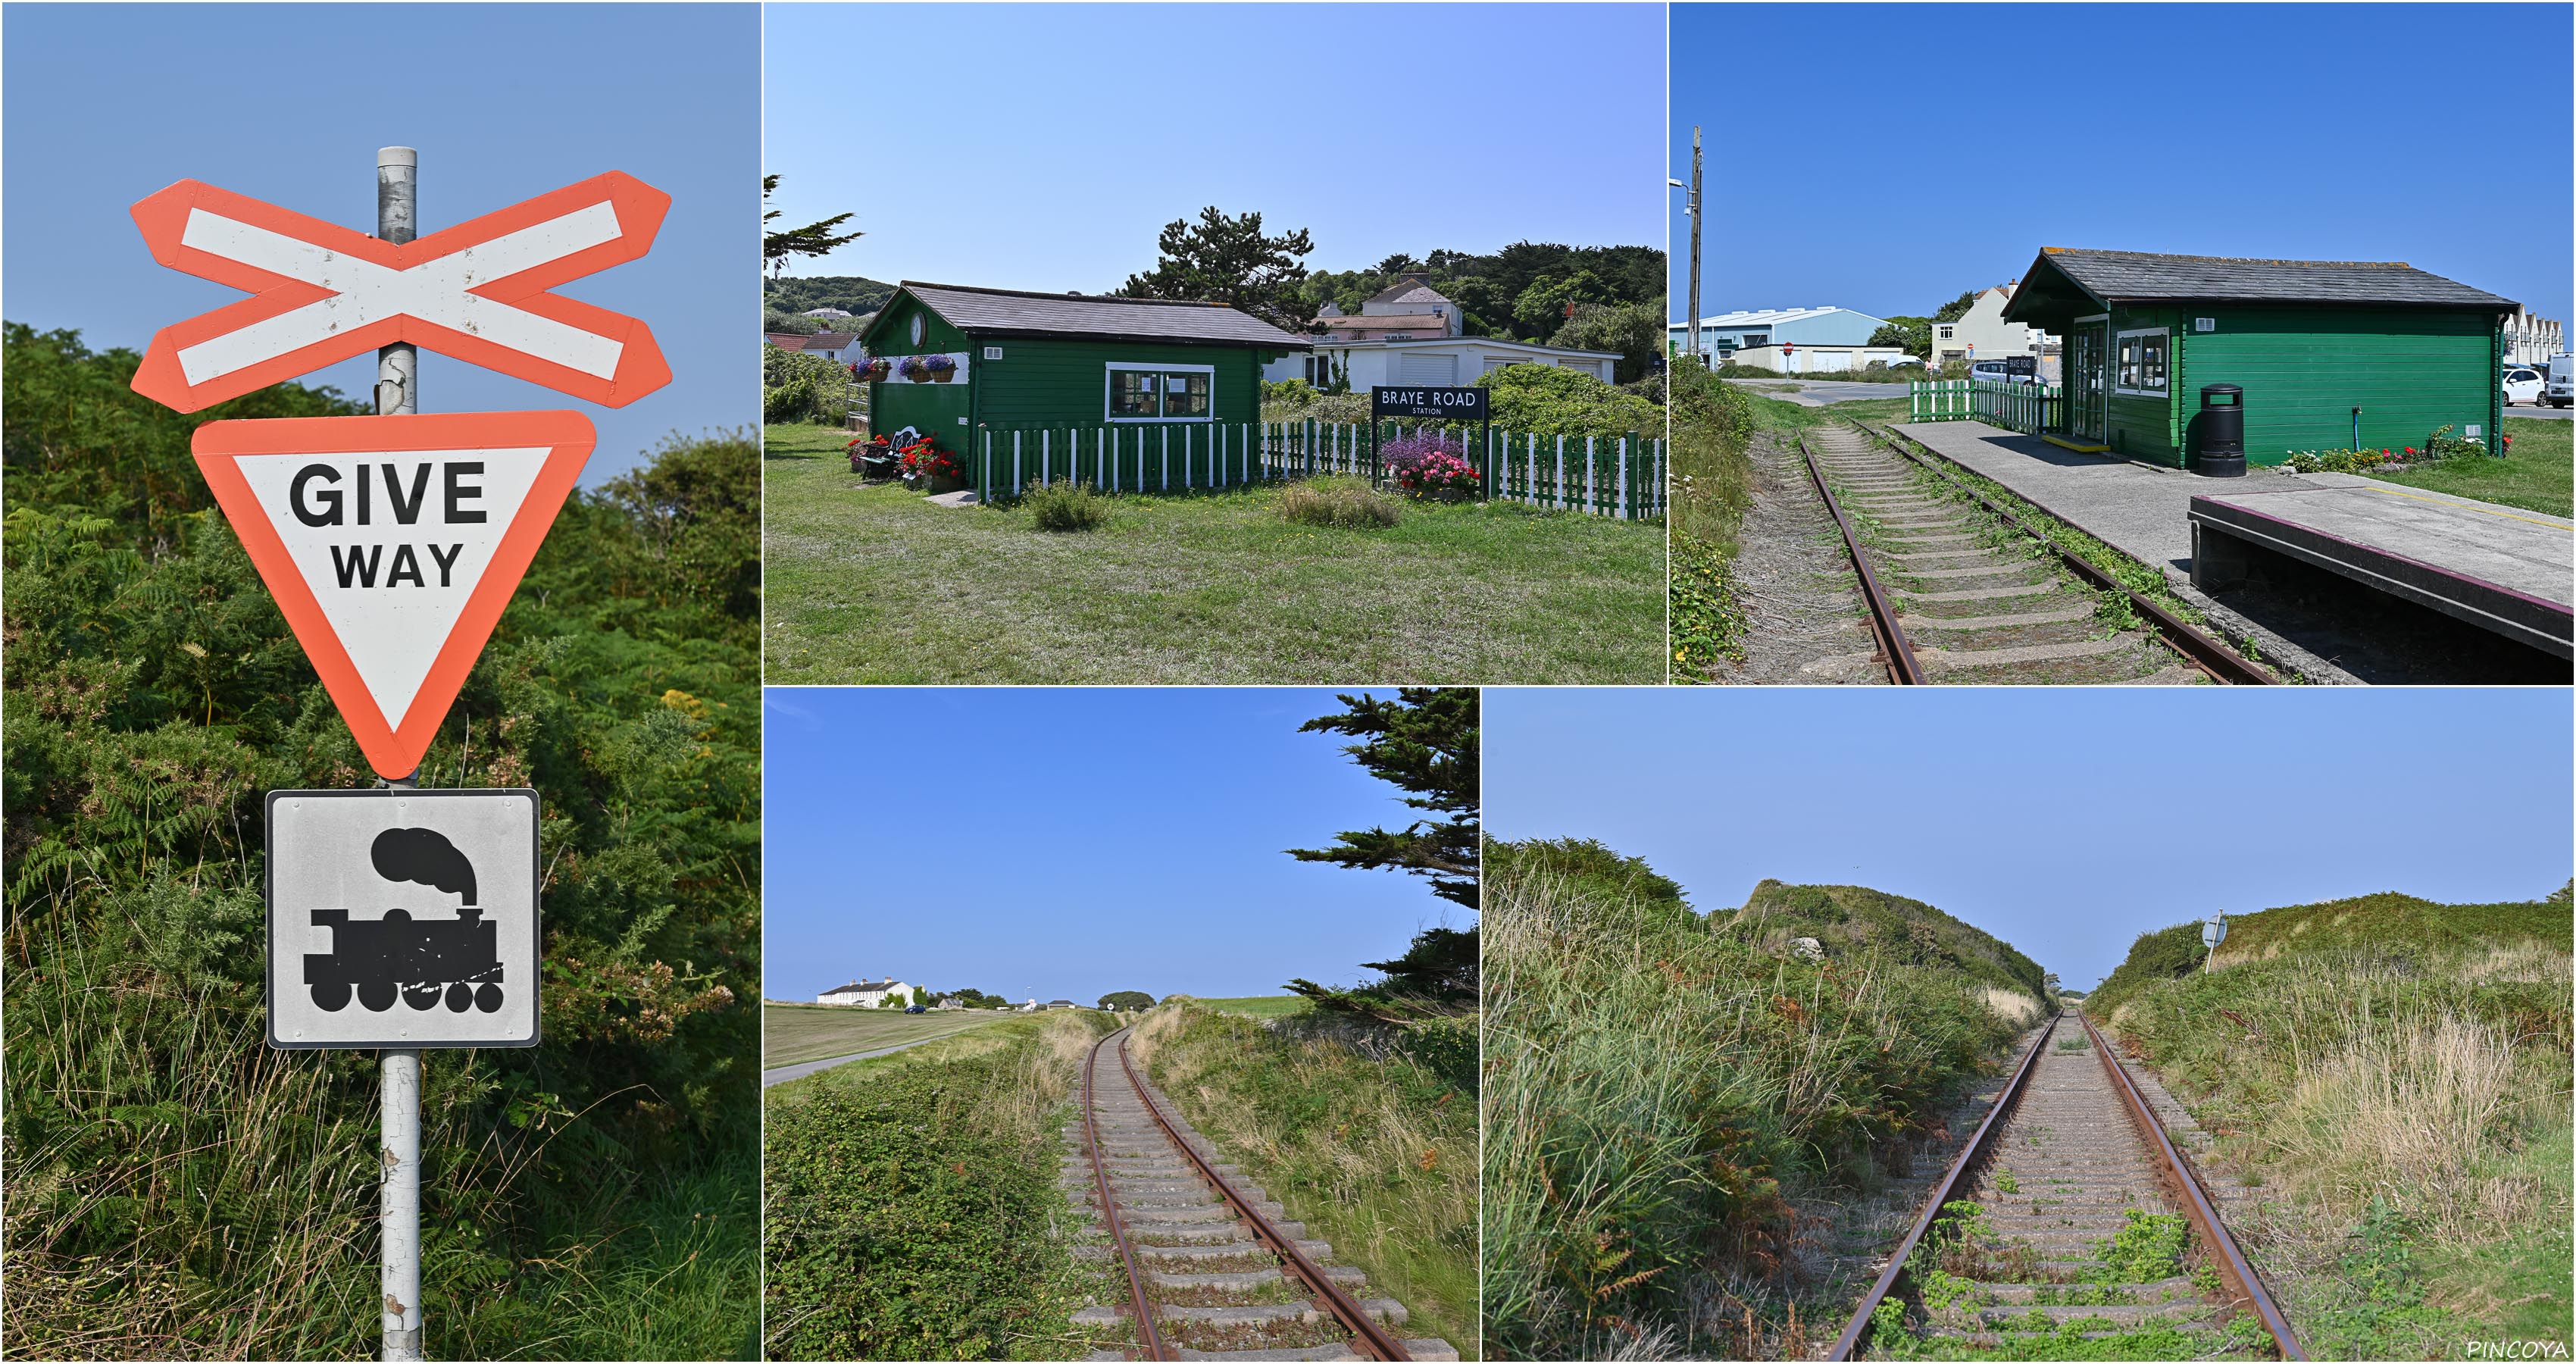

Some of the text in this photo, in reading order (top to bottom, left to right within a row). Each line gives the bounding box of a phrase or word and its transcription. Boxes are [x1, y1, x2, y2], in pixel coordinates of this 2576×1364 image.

[1382, 391, 1475, 406] BRAYE ROAD
[289, 462, 487, 527] GIVE
[330, 543, 464, 589] WAY
